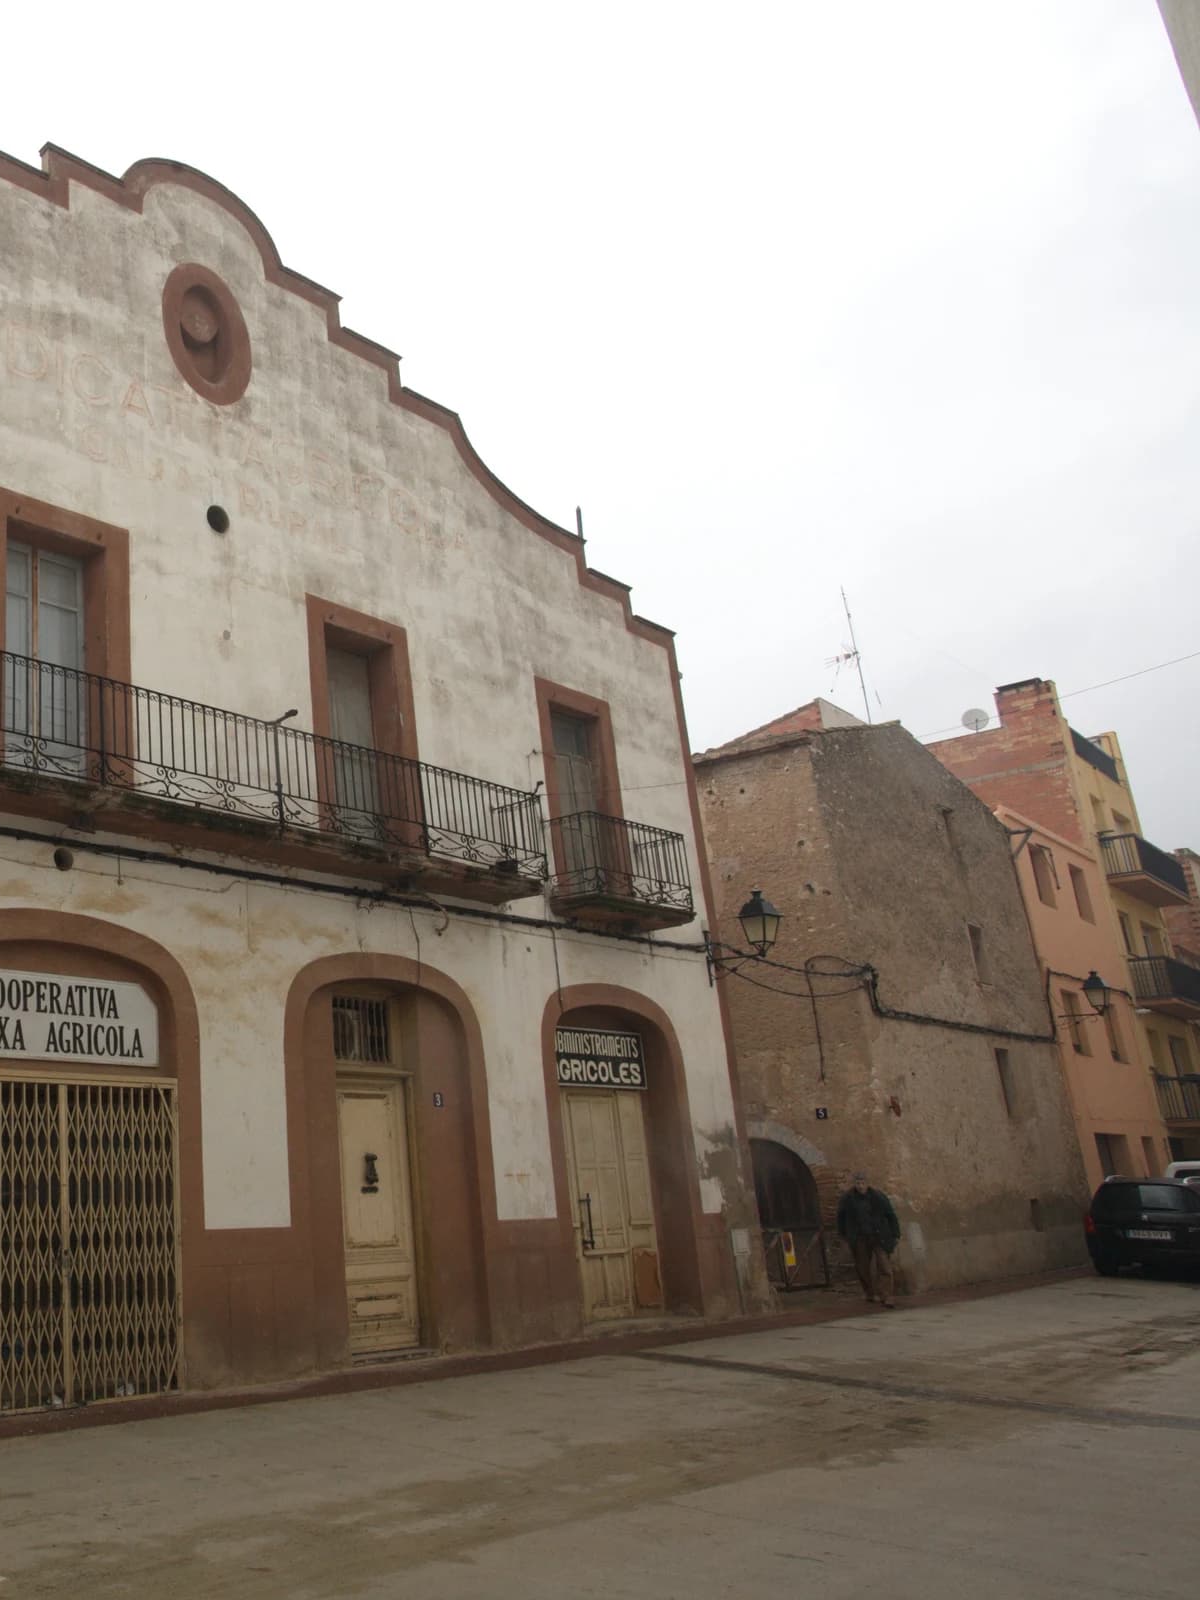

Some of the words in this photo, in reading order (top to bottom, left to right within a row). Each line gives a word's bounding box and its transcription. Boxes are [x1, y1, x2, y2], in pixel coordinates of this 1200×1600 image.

[45, 1021, 144, 1059] AGRICOLA
[557, 1059, 642, 1085] GRICOLES
[435, 1093, 441, 1106] 3
